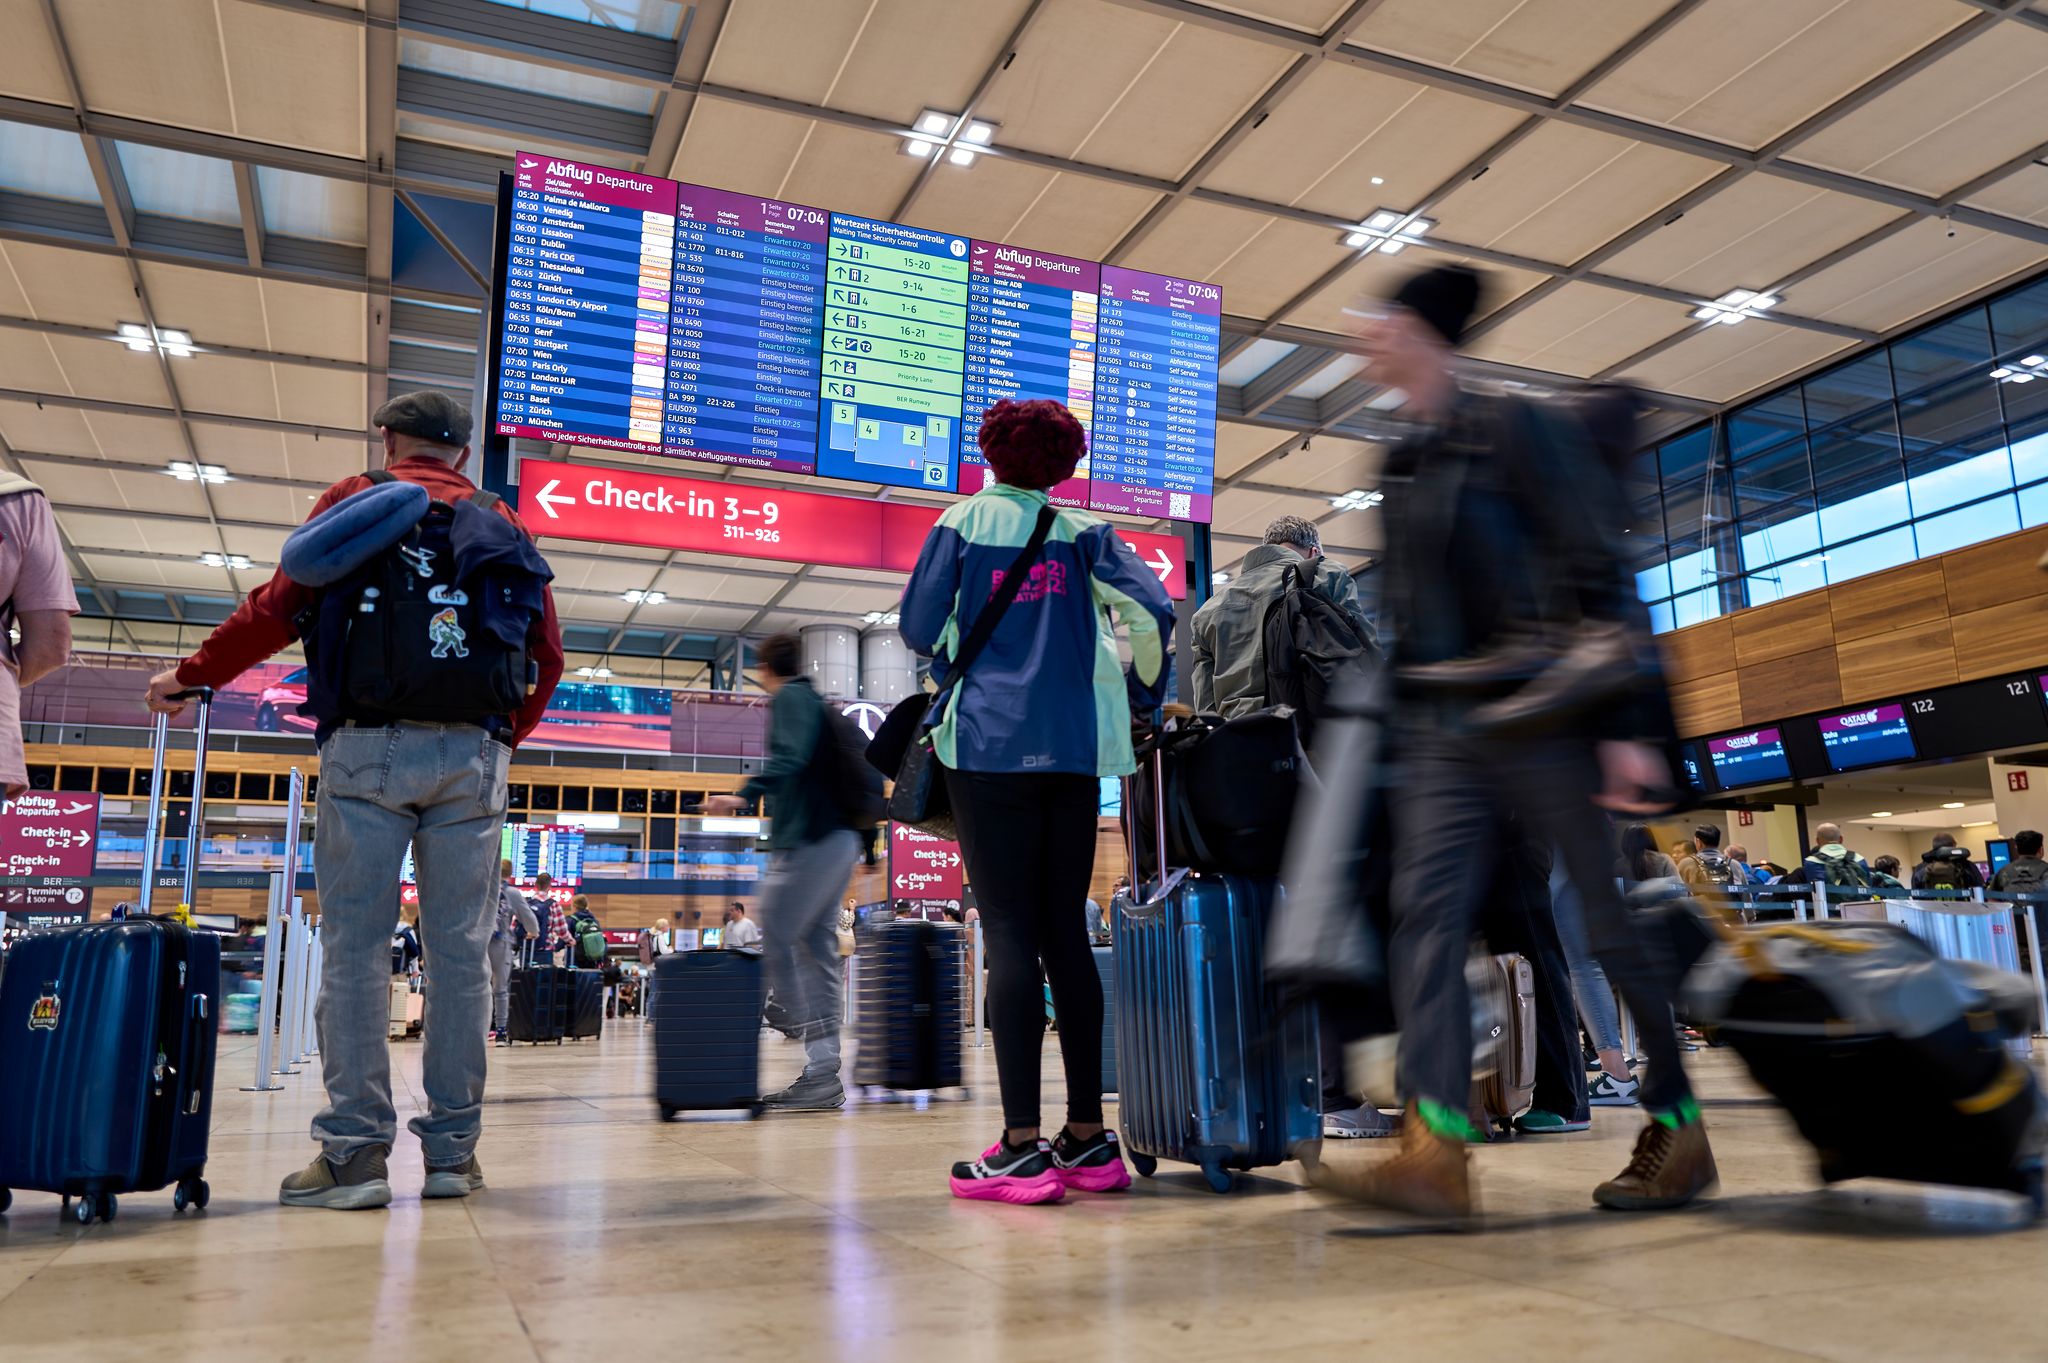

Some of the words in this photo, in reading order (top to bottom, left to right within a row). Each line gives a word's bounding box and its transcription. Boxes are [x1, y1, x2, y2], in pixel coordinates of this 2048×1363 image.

[546, 162, 592, 184] Abflug
[597, 173, 653, 193] Departure
[546, 178, 572, 188] Ziel/über
[545, 186, 584, 198] Destination/via
[518, 190, 539, 200] 05:20
[544, 194, 567, 205] Palma
[579, 201, 610, 212] Mallorca
[517, 201, 538, 211] 06:00
[544, 206, 573, 218] Venedig
[761, 203, 766, 214] 1
[788, 208, 824, 225] 07:04
[516, 212, 538, 222] 06:00
[542, 217, 584, 230] Amsterdam
[718, 210, 740, 220] Schalter
[765, 220, 795, 231] Bemerkung
[515, 224, 536, 233] 06:00
[542, 228, 573, 239] Lissabon
[690, 222, 706, 231] 2412
[717, 227, 745, 237] 011-012
[833, 216, 870, 231] Wartezeit
[872, 225, 945, 244] Sicherheitskontrolle
[515, 234, 536, 244] 06:10
[541, 239, 565, 249] Dublin
[833, 226, 855, 237] Waiting
[857, 230, 871, 239] Time
[873, 233, 896, 244] Security
[897, 238, 918, 248] Control
[514, 246, 534, 255] 06:15
[540, 250, 558, 259] Paris
[560, 253, 575, 262] CDG
[995, 248, 1032, 268] Abflug
[1036, 258, 1080, 274] Departure
[513, 257, 534, 266] 06:25
[539, 261, 584, 274] Thessaloniki
[904, 258, 930, 270] 15-20
[512, 268, 533, 277] 06:45
[538, 272, 561, 282] Zürich
[973, 274, 989, 283] 07:20
[512, 279, 532, 288] 06:45
[538, 283, 573, 295] Frankfurt
[762, 278, 787, 289] Einstieg
[788, 282, 814, 292] beendet
[864, 275, 869, 283] 2
[903, 281, 923, 291] 9-14
[1165, 280, 1172, 291] 2
[1188, 284, 1218, 300] 07:04
[511, 290, 531, 300] 06:55
[537, 294, 564, 305] London
[566, 299, 580, 309] City
[582, 302, 607, 311] Airport
[972, 294, 988, 303] 07:30
[510, 301, 530, 311] 06:55
[536, 306, 576, 318] Köln/Bonn
[863, 298, 868, 306] 4
[902, 304, 916, 314] 1-6
[509, 312, 530, 322] 06:55
[536, 316, 562, 327] Brüssel
[508, 324, 529, 333] 07:00
[535, 328, 553, 336] Genf
[901, 327, 925, 338] 16-21
[507, 335, 528, 344] 07:00
[534, 339, 568, 350] Stuttgart
[506, 346, 527, 356] 07:00
[533, 350, 552, 359] Wien
[900, 349, 925, 360] 15-20
[506, 357, 527, 367] 07:00
[532, 361, 550, 370] Paris
[552, 364, 568, 374] Orly
[505, 369, 526, 378] 07:05
[532, 372, 559, 382] London
[561, 377, 576, 385] LHR
[898, 373, 918, 382] Priority
[968, 375, 984, 383] 08:15
[989, 378, 1020, 388] Köln/Bonn
[504, 380, 525, 389] 07:10
[531, 384, 548, 392] Rom
[550, 386, 564, 394] FCO
[503, 391, 524, 400] 07:15
[530, 395, 550, 404] Basel
[707, 398, 735, 408] 221-226
[909, 398, 930, 406] Runway
[502, 402, 523, 412] 07:15
[529, 406, 552, 416] Zürich
[841, 409, 846, 418] 5
[502, 414, 523, 423] 07:20
[528, 418, 562, 428] München
[936, 423, 940, 432] 1
[501, 426, 516, 434] BER
[866, 425, 872, 434] 4
[910, 431, 916, 440] 2
[542, 431, 557, 439] Von
[557, 432, 576, 441] jeder
[578, 435, 646, 450] Sicherheitskontrolle
[647, 444, 662, 452] sind
[665, 447, 696, 458] sämtliche
[698, 451, 737, 463] Abfluggates
[739, 457, 773, 467] erreichbar.
[584, 479, 715, 518] Check-in
[1134, 496, 1162, 505] Departures
[1106, 503, 1129, 512] Baggage
[2006, 680, 2030, 695] 121
[1912, 698, 1935, 713] 122
[1840, 713, 1866, 725] QATAR
[1726, 737, 1749, 747] QATAR
[17, 796, 56, 808] Abflug
[16, 807, 60, 817] Departure
[21, 827, 71, 838] Check-in
[10, 855, 60, 866] Check-in
[914, 850, 947, 859] Check-in
[43, 877, 62, 886] BER
[909, 873, 942, 881] Check-in
[27, 887, 64, 895] Terminal
